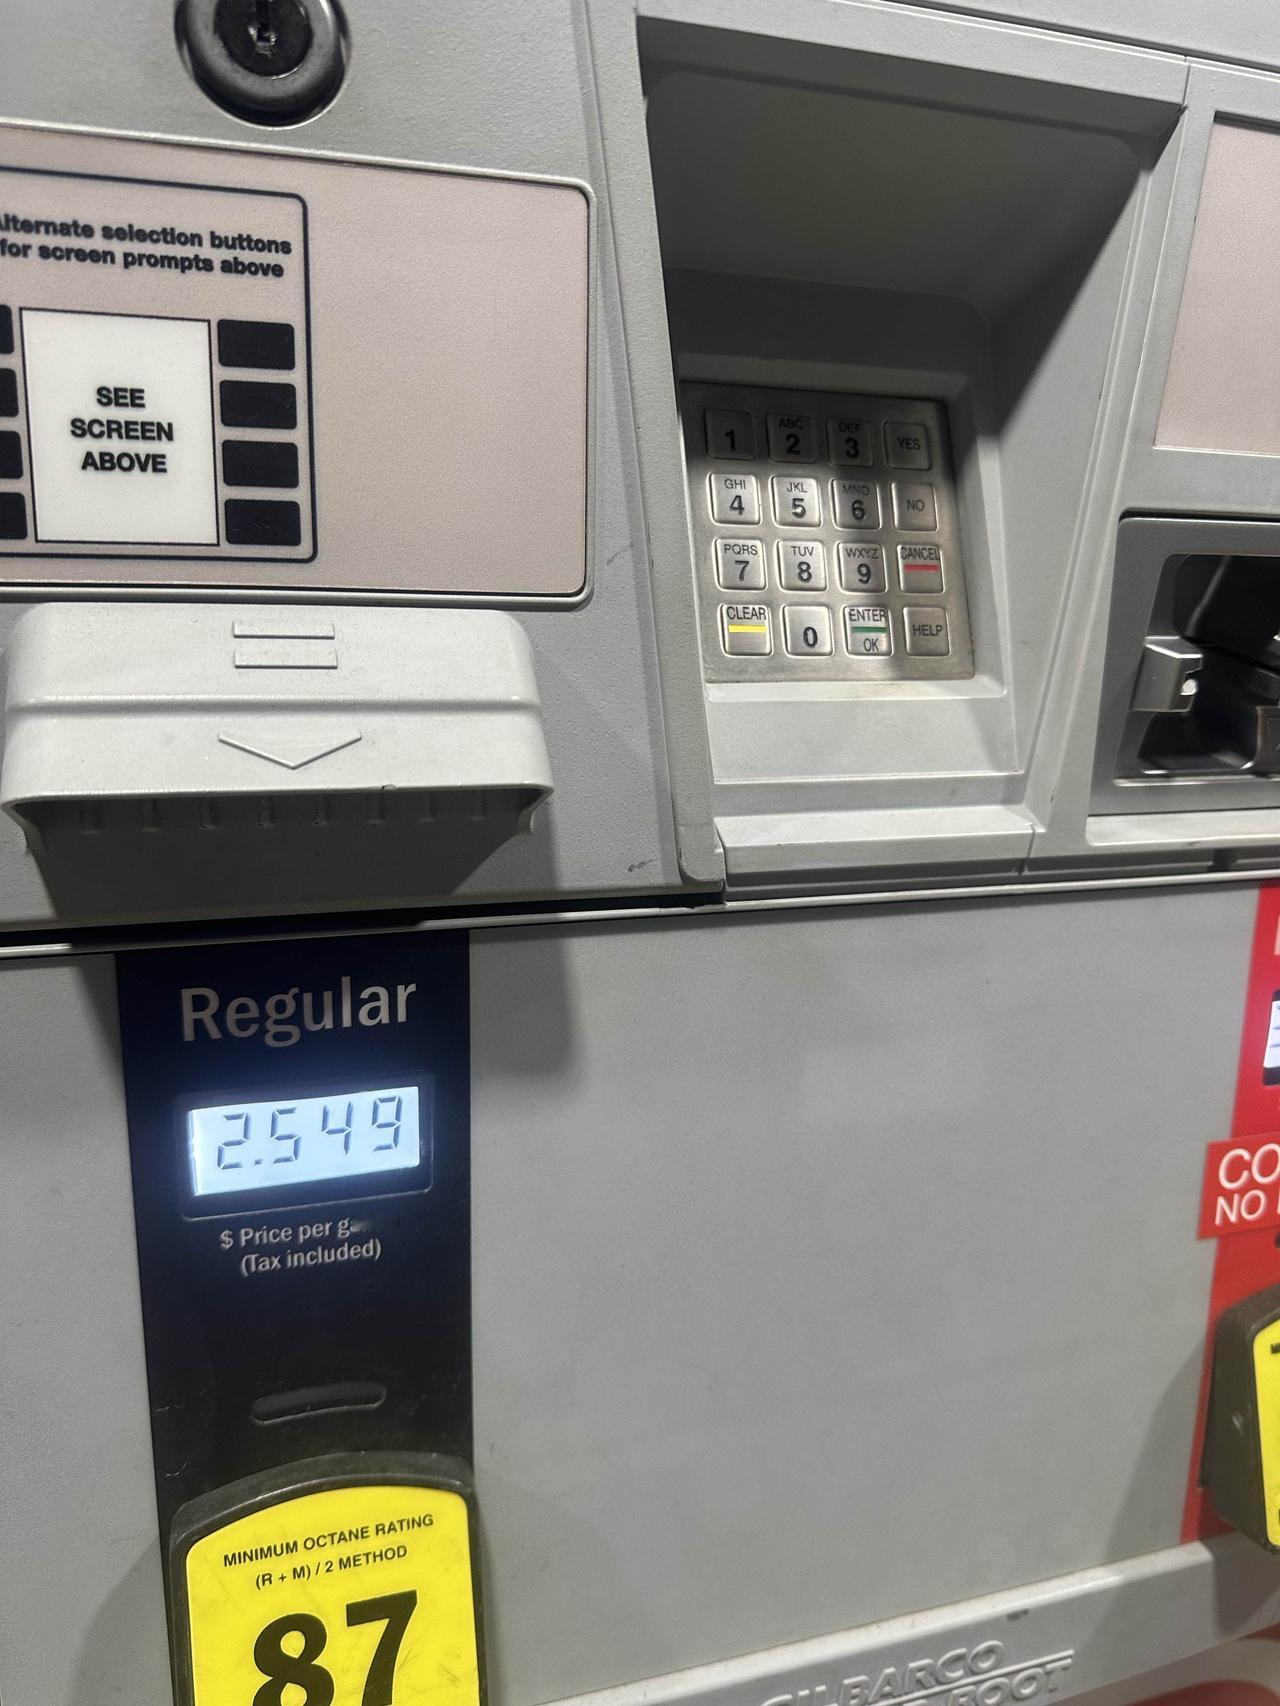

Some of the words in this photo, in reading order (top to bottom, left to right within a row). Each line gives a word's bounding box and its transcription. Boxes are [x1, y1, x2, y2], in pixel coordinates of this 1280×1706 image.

[0, 213, 95, 239] lternate
[102, 223, 203, 247] selection
[210, 231, 292, 254] buttons
[0, 238, 32, 258] for
[38, 244, 116, 264] screen
[123, 251, 214, 273] prompts
[220, 257, 284, 277] above
[96, 386, 146, 408] SEE
[70, 417, 174, 441] SCREEN
[778, 418, 803, 430] ABC
[839, 422, 861, 433] DEF
[725, 430, 736, 451] 1
[785, 433, 801, 454] 2
[845, 438, 860, 458] 3
[897, 438, 921, 450] YES
[81, 451, 167, 473] ABOVE
[724, 478, 746, 490] GHI
[786, 482, 808, 493] JKL
[843, 484, 870, 496] MNO
[730, 494, 745, 516] 4
[791, 497, 806, 519] 5
[851, 499, 866, 521] 6
[906, 499, 925, 512] NO
[724, 543, 758, 556] PQRS
[791, 546, 814, 557] TUV
[845, 548, 879, 560] WXYZ
[900, 547, 940, 561] CANCEL
[734, 560, 750, 582] 7
[797, 561, 812, 583] 8
[856, 563, 871, 584] 9
[726, 606, 767, 621] CLEAR
[849, 608, 888, 622] ENTER
[803, 626, 818, 648] 0
[912, 624, 943, 637] HELP
[863, 638, 879, 652] OK
[180, 976, 416, 1048] Regular
[217, 1096, 402, 1170] 2.549
[1214, 1189, 1267, 1226] NO
[220, 1229, 234, 1250] $
[240, 1226, 293, 1247] Price
[299, 1221, 333, 1243] per
[240, 1252, 282, 1278] (Tax
[287, 1238, 382, 1268] included)
[223, 1540, 298, 1567] MINIMUM
[303, 1526, 370, 1551] OCTANE
[375, 1513, 434, 1537] RATING
[256, 1573, 273, 1590] (R
[292, 1563, 311, 1580] M)
[325, 1560, 334, 1573] 2
[339, 1544, 408, 1571] METHOD
[253, 1589, 418, 1706] 87
